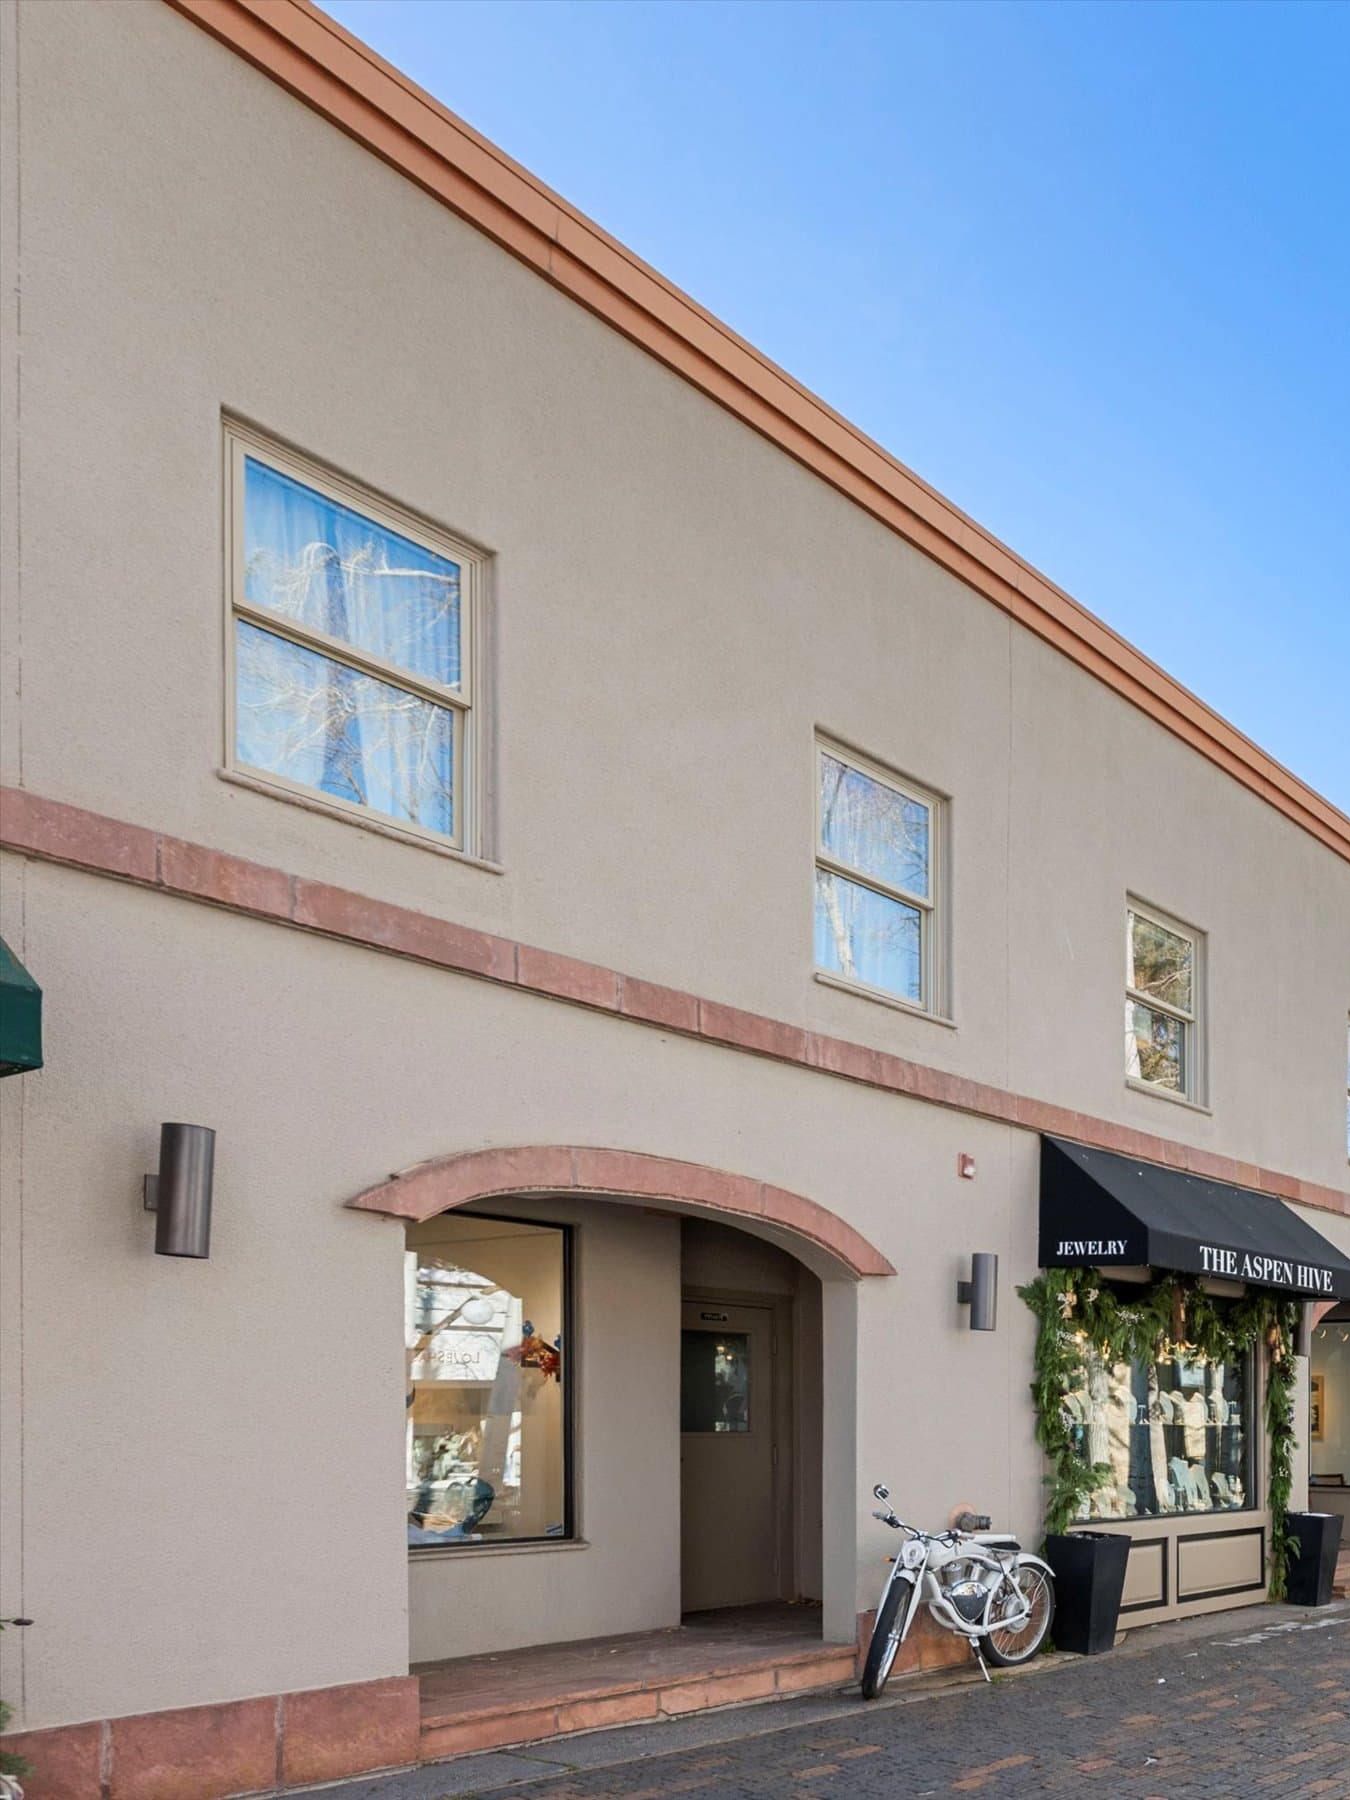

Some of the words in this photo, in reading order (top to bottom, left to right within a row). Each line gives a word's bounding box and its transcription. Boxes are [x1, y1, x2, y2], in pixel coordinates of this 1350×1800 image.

[1056, 1240, 1128, 1256] JEWELRY
[1200, 1246, 1237, 1274] THE
[1241, 1253, 1293, 1283] ASPEN
[1297, 1266, 1333, 1292] HIVE
